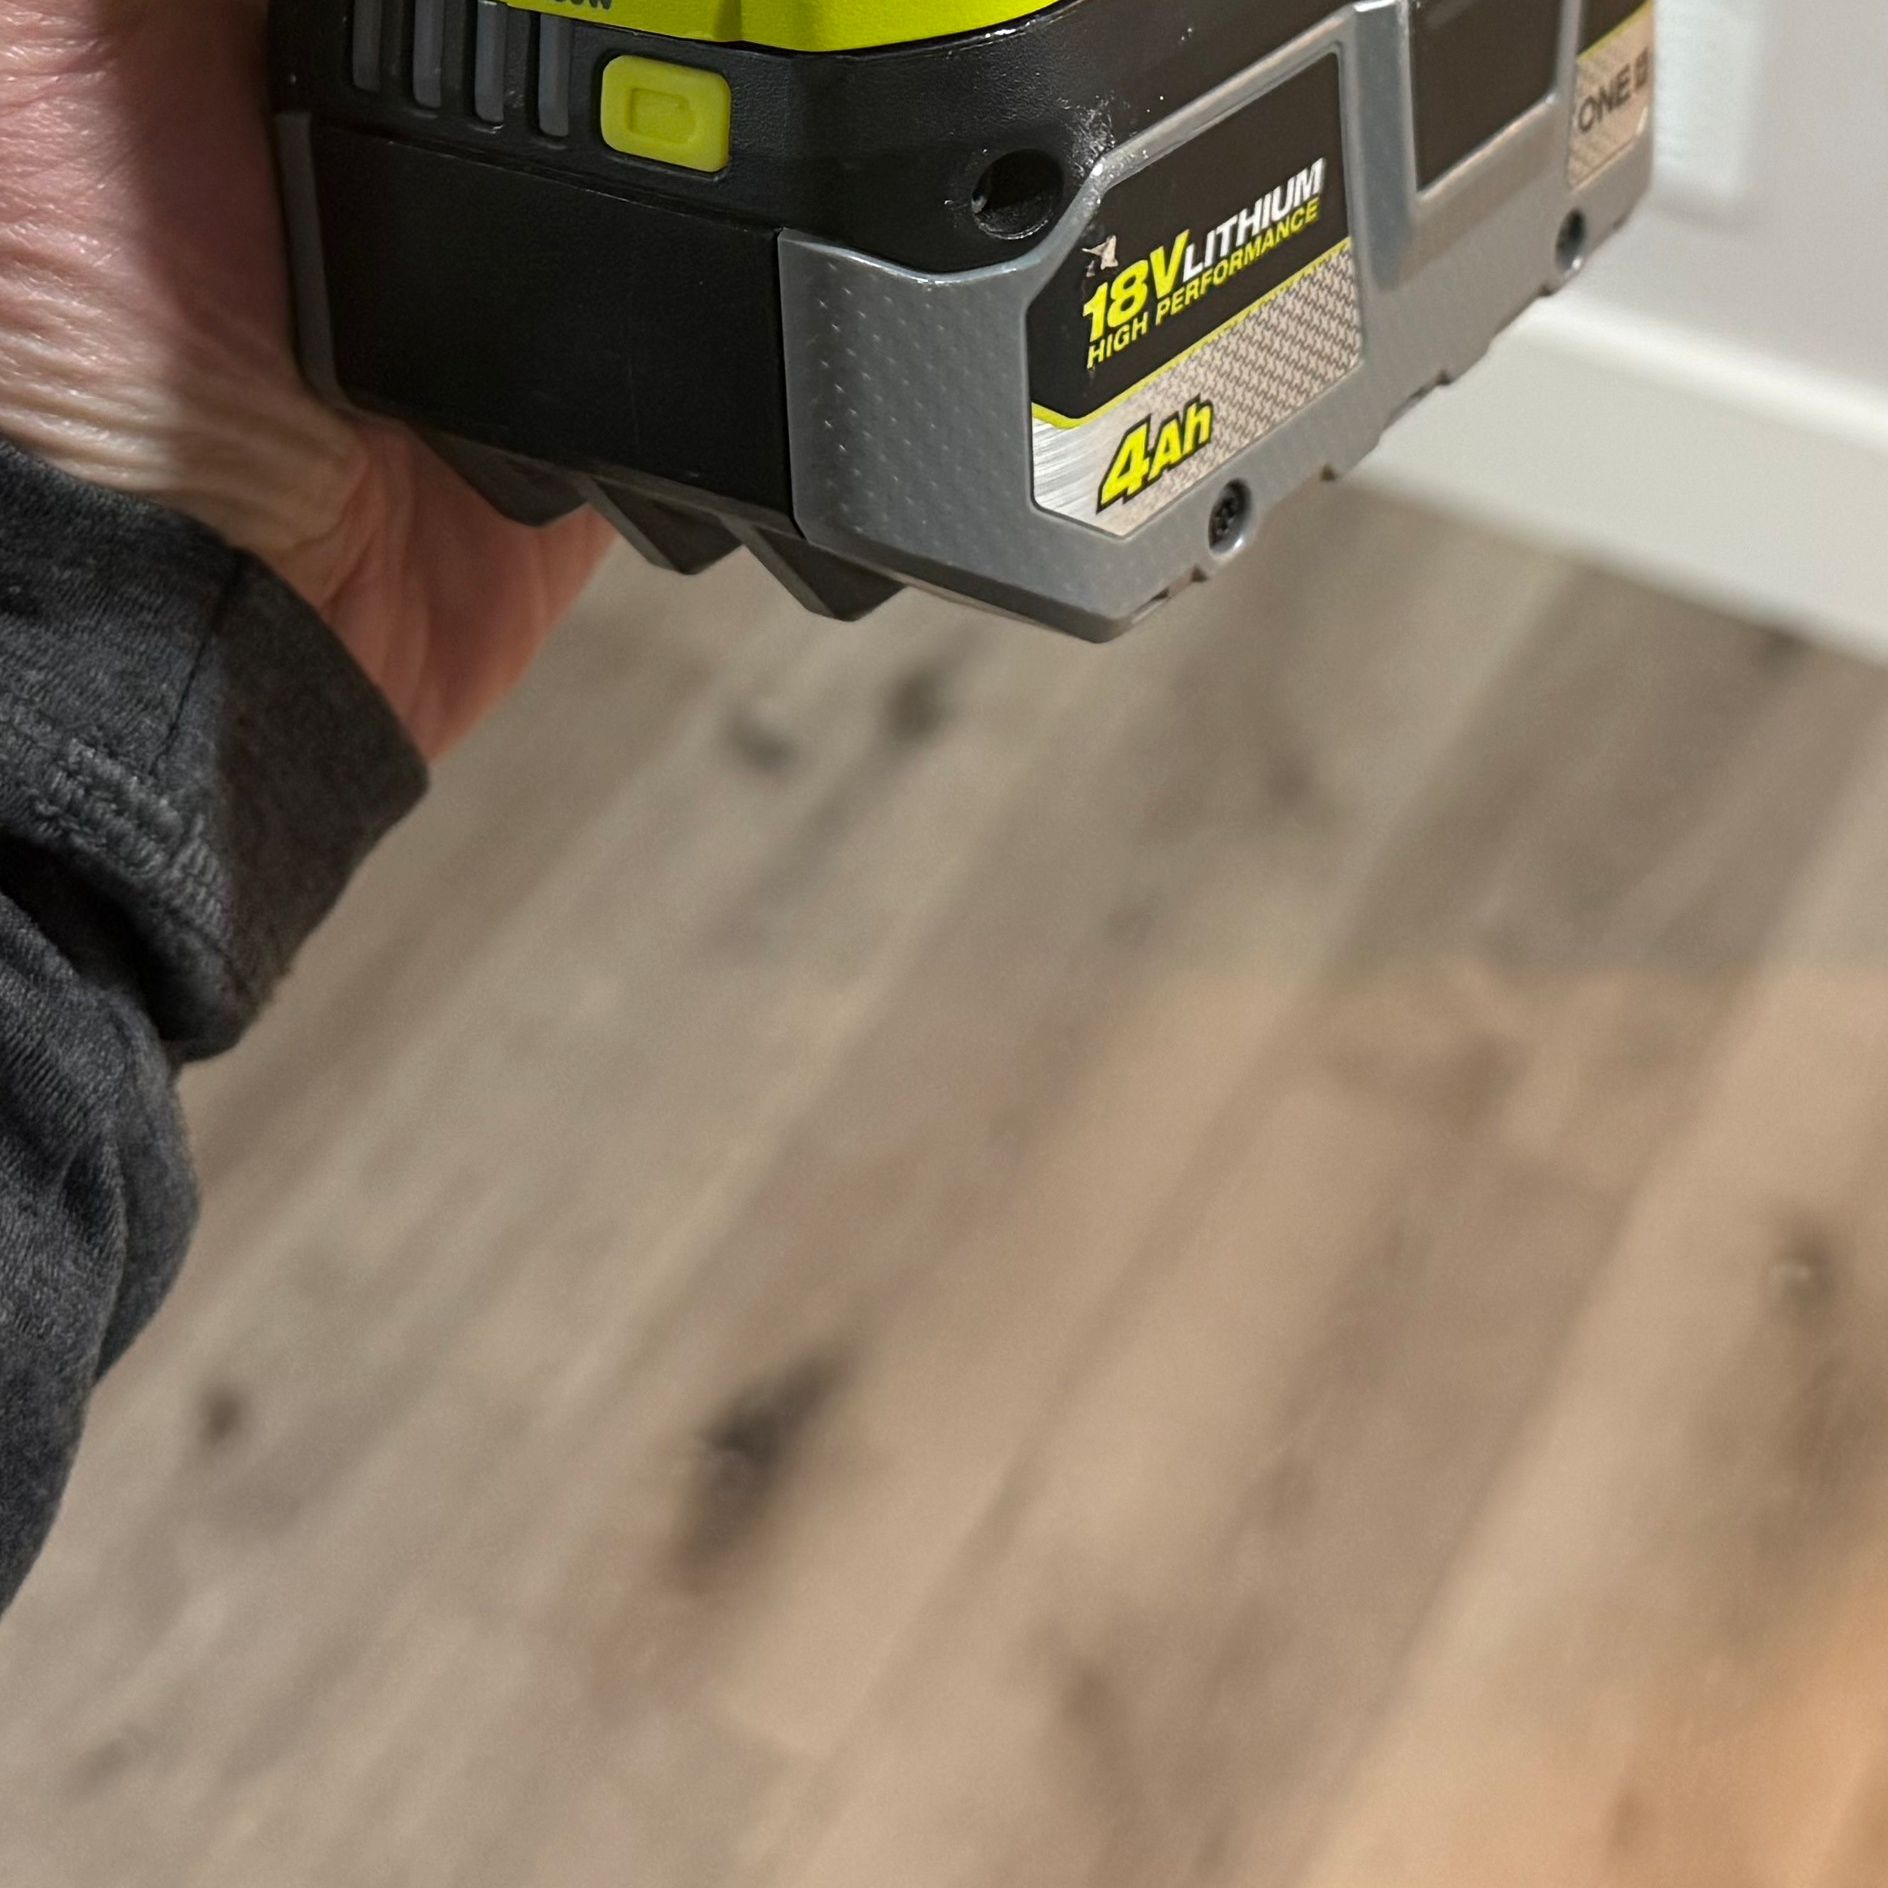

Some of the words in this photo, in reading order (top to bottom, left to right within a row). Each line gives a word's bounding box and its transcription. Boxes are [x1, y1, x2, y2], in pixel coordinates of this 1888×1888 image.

[1086, 311, 1149, 370] HIGH
[1155, 196, 1320, 326] PERFORMANCE
[1096, 393, 1213, 515] 4Ah
